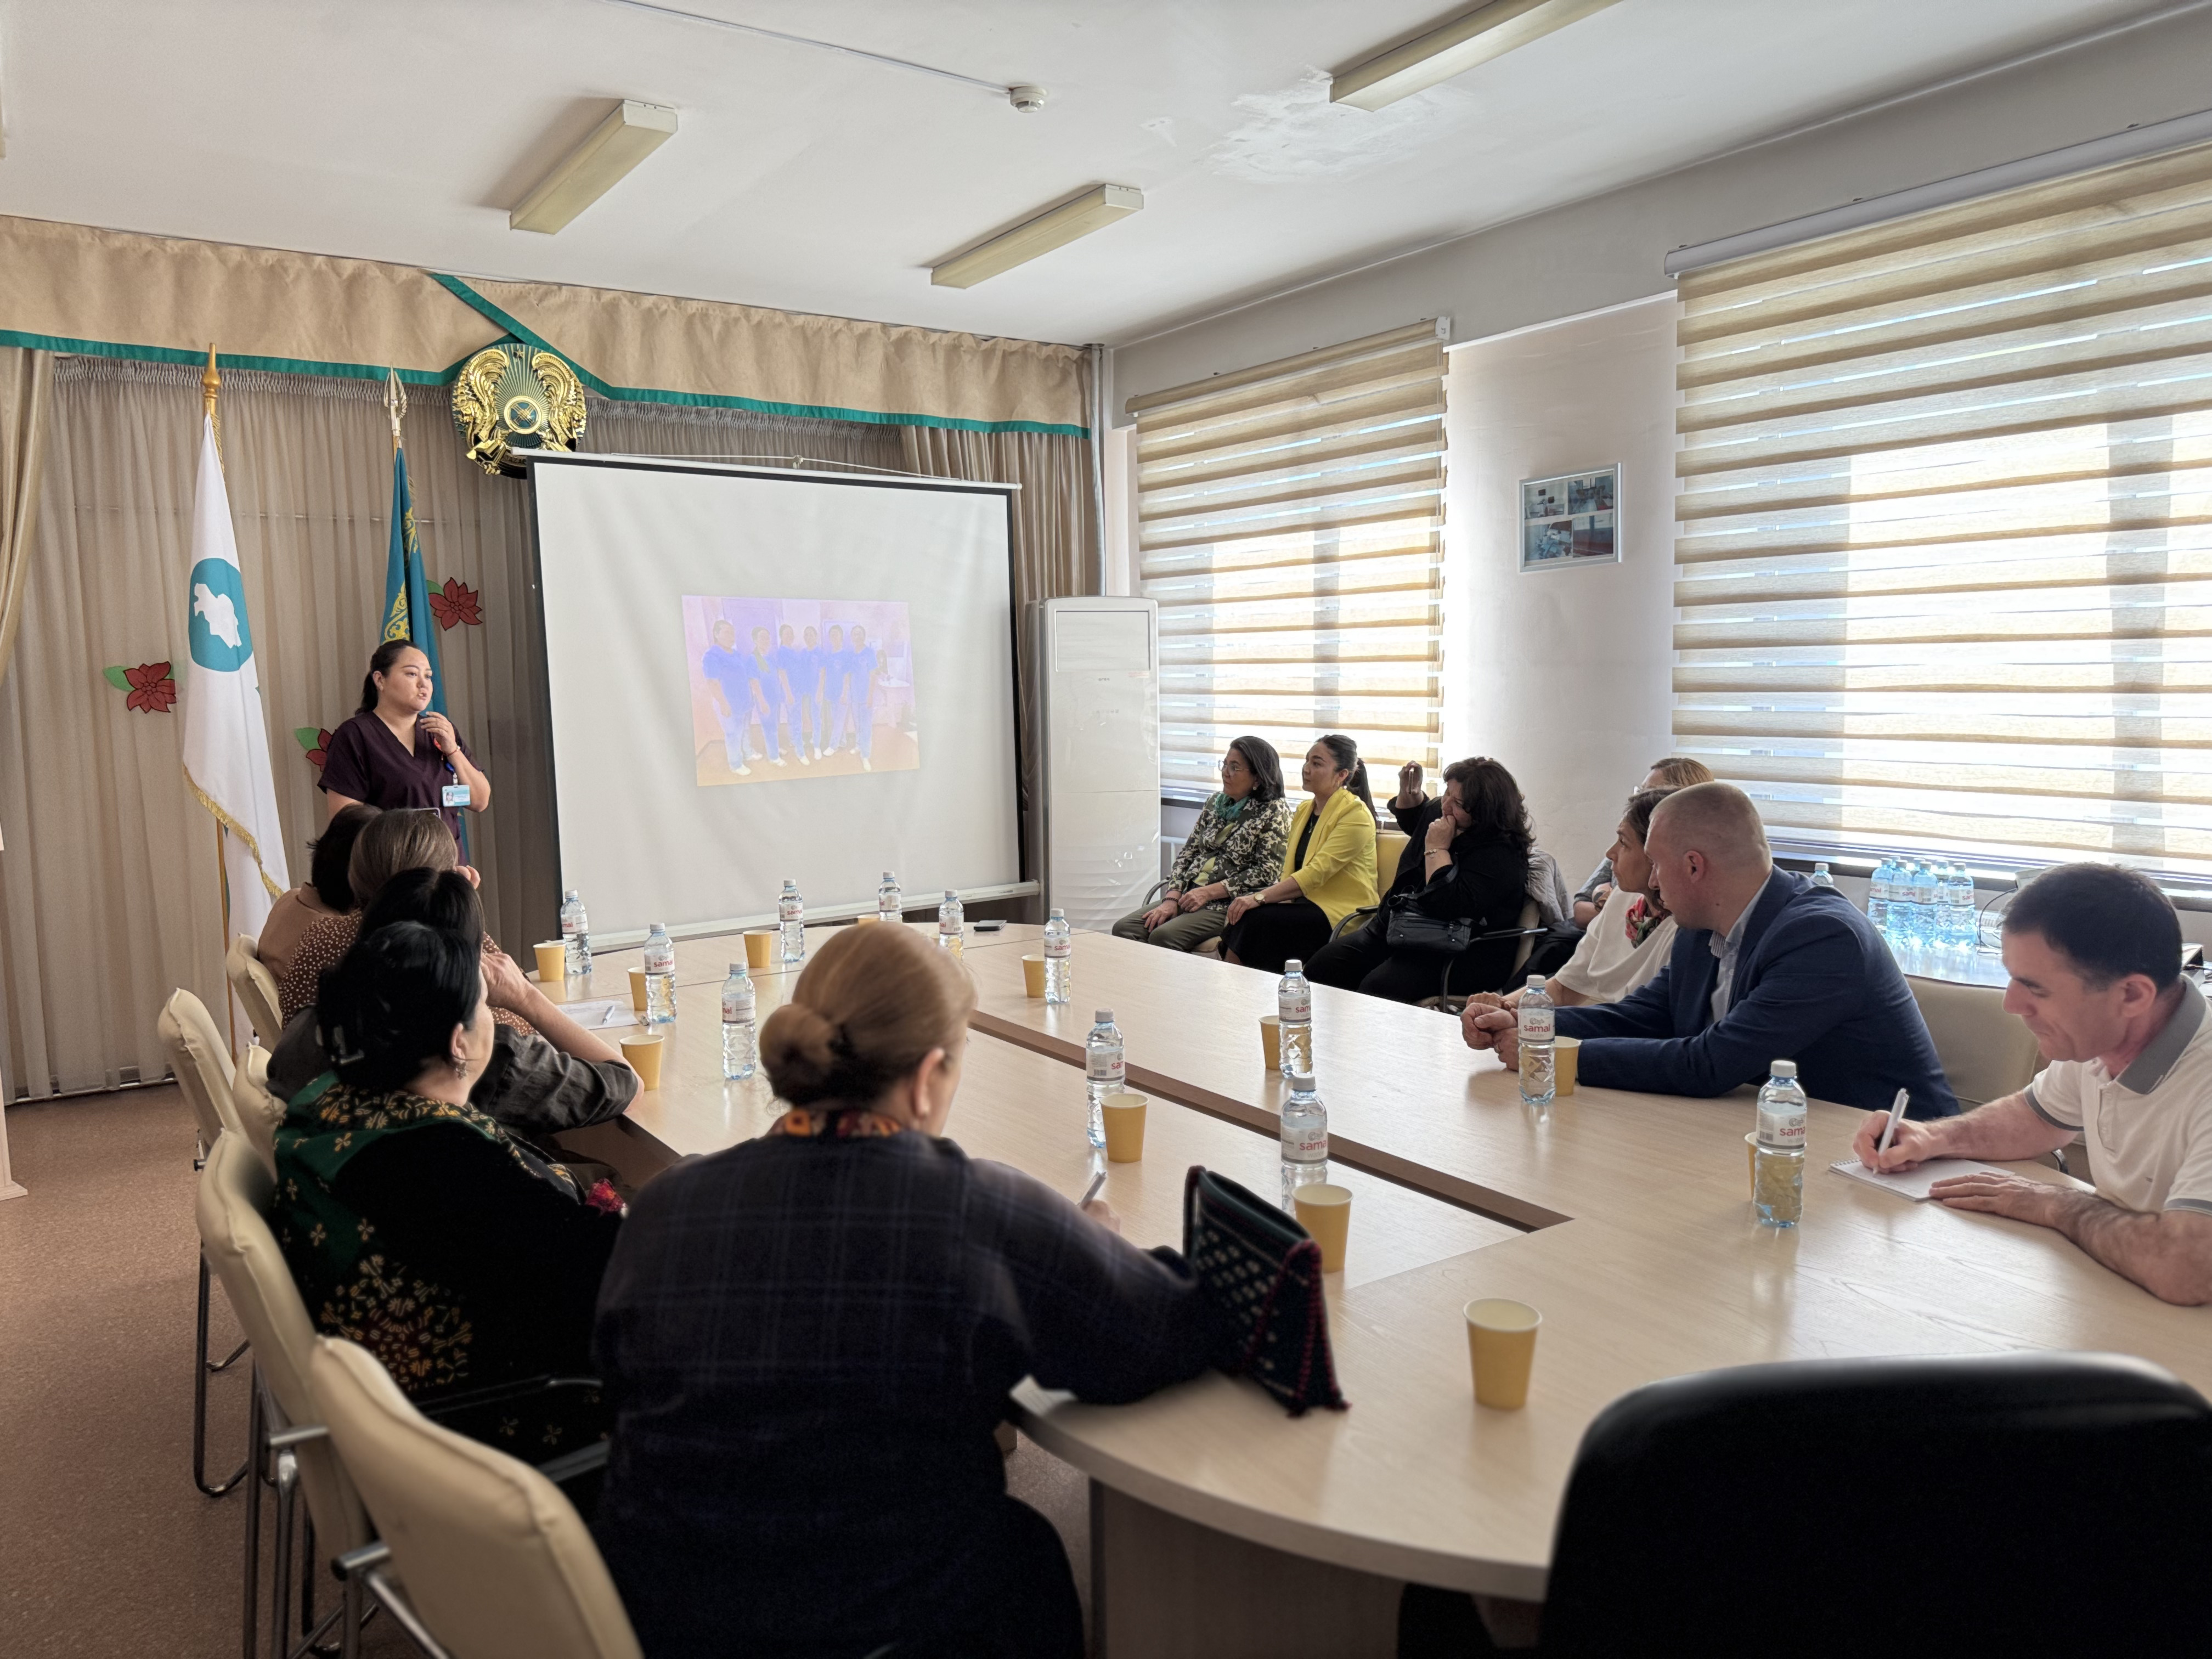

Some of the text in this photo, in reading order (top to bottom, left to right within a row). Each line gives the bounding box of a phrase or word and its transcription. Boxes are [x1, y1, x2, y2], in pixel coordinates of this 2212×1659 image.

[1523, 1023, 1551, 1032] samal
[1779, 1126, 1805, 1137] sama
[1299, 1140, 1327, 1150] sama
